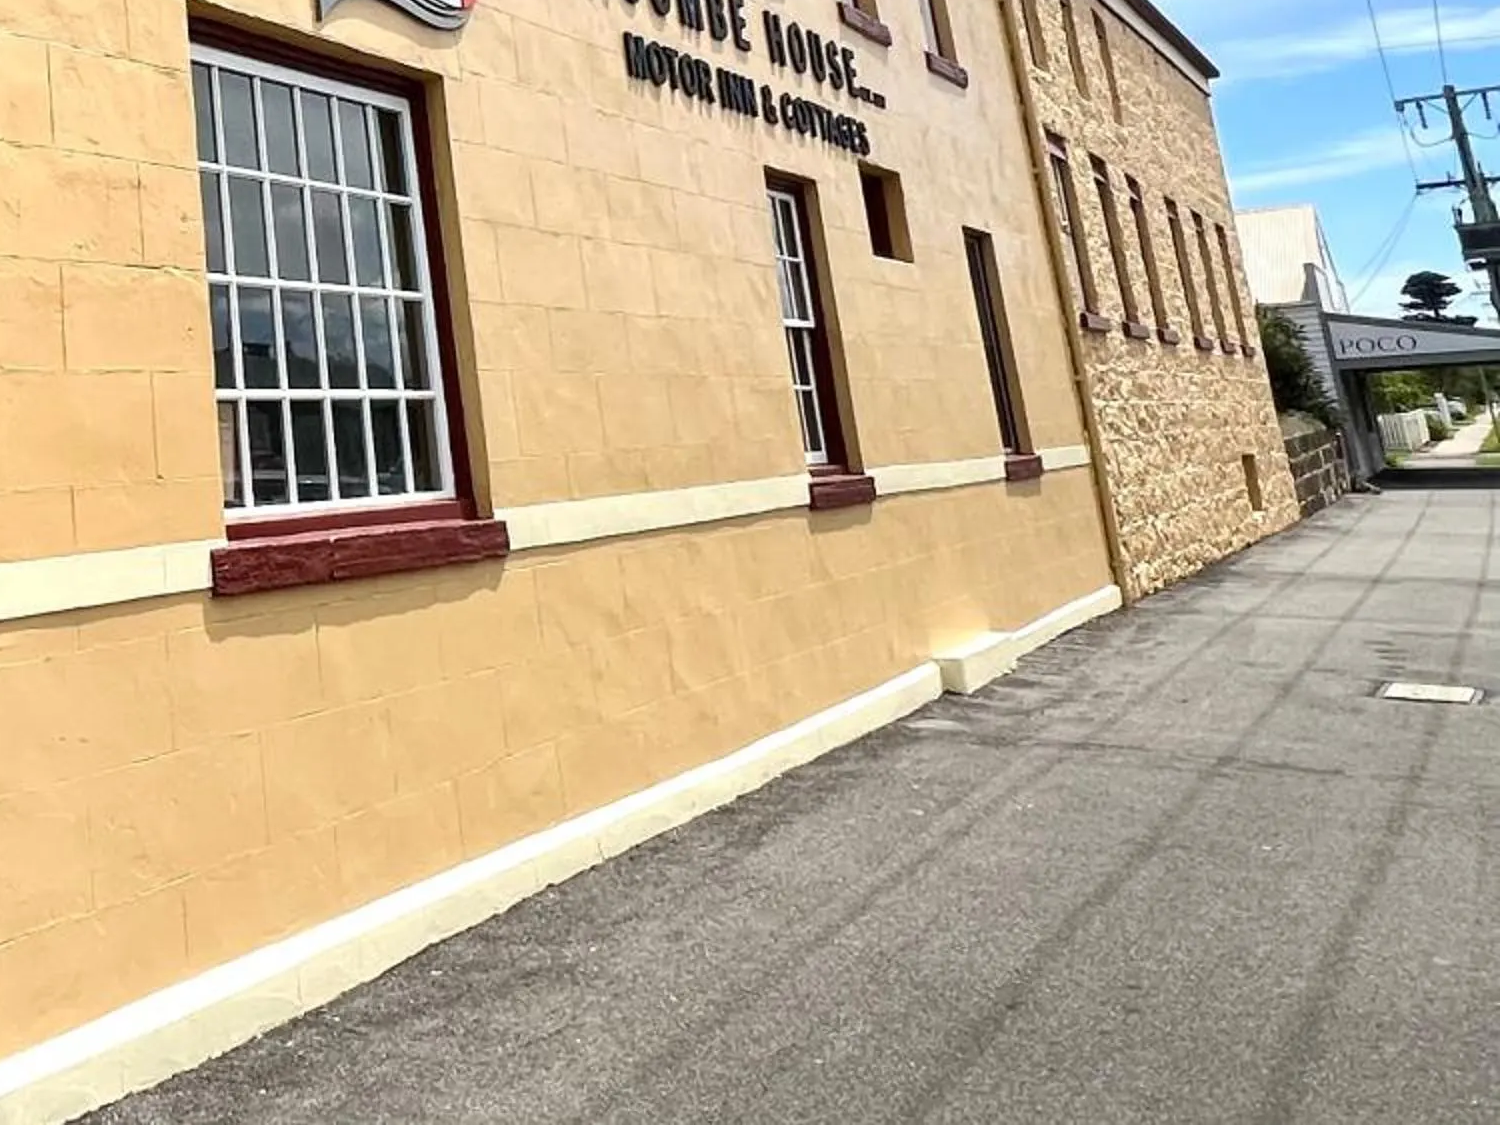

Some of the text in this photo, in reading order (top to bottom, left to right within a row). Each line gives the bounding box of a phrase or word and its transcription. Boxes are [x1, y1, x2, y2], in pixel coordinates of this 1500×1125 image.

[623, 31, 716, 104] MOTOR
[716, 67, 759, 117] INN
[760, 84, 779, 125] &
[779, 92, 871, 157] COTTAGES
[763, 10, 860, 99] HOUSE
[1339, 335, 1417, 354] POCO
